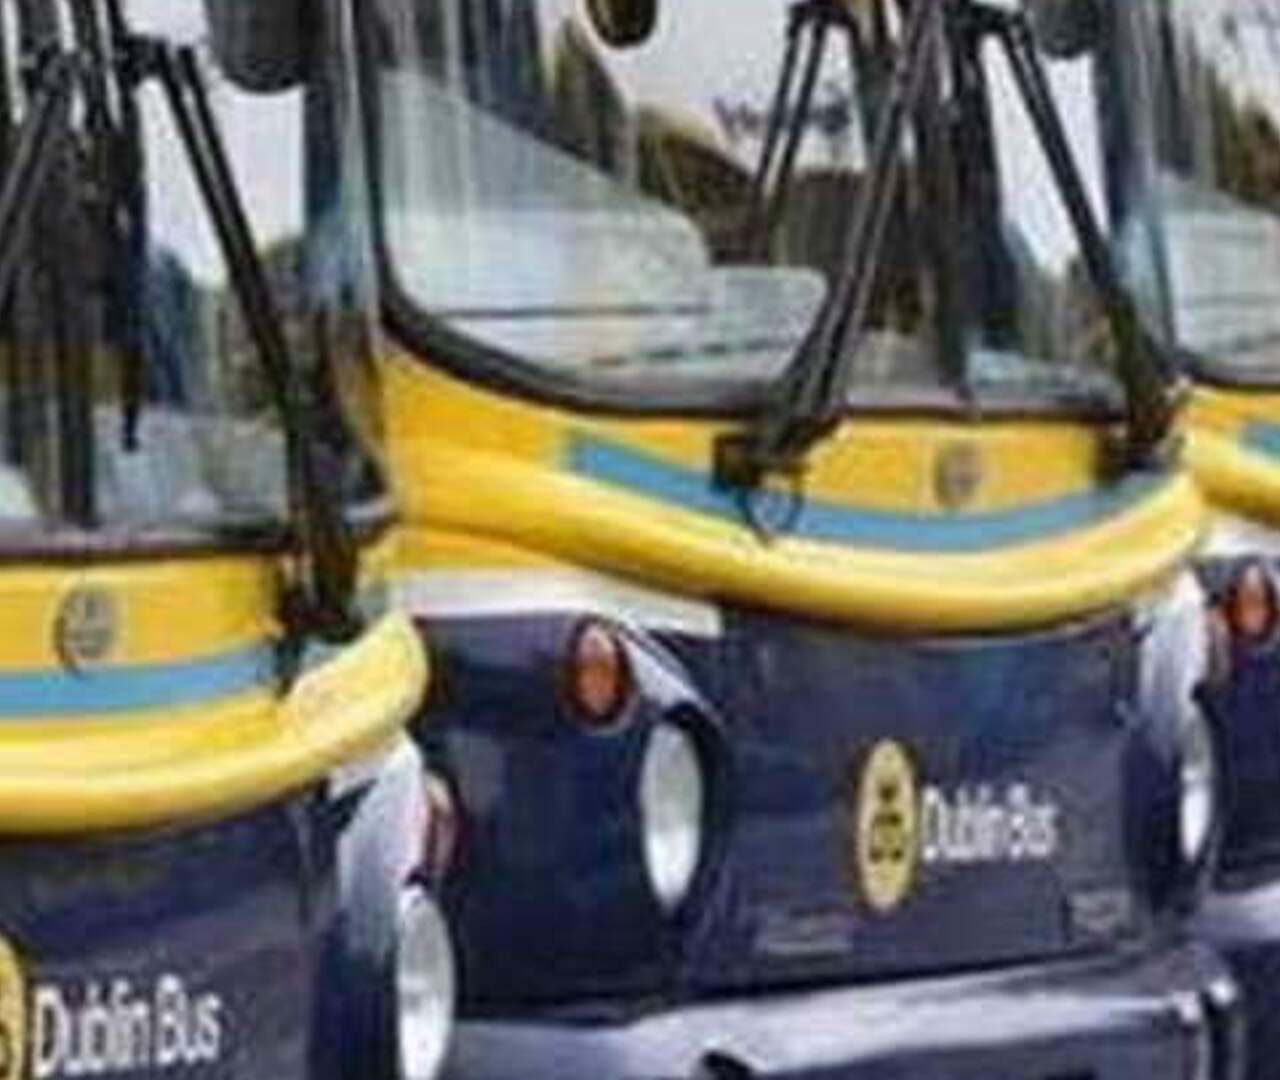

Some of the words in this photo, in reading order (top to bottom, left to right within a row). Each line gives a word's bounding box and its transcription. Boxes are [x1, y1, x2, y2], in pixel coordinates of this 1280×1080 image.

[922, 784, 1003, 860] Dublin
[1006, 782, 1058, 858] Bus
[30, 980, 151, 1078] Dublin
[154, 972, 222, 1065] Bus
